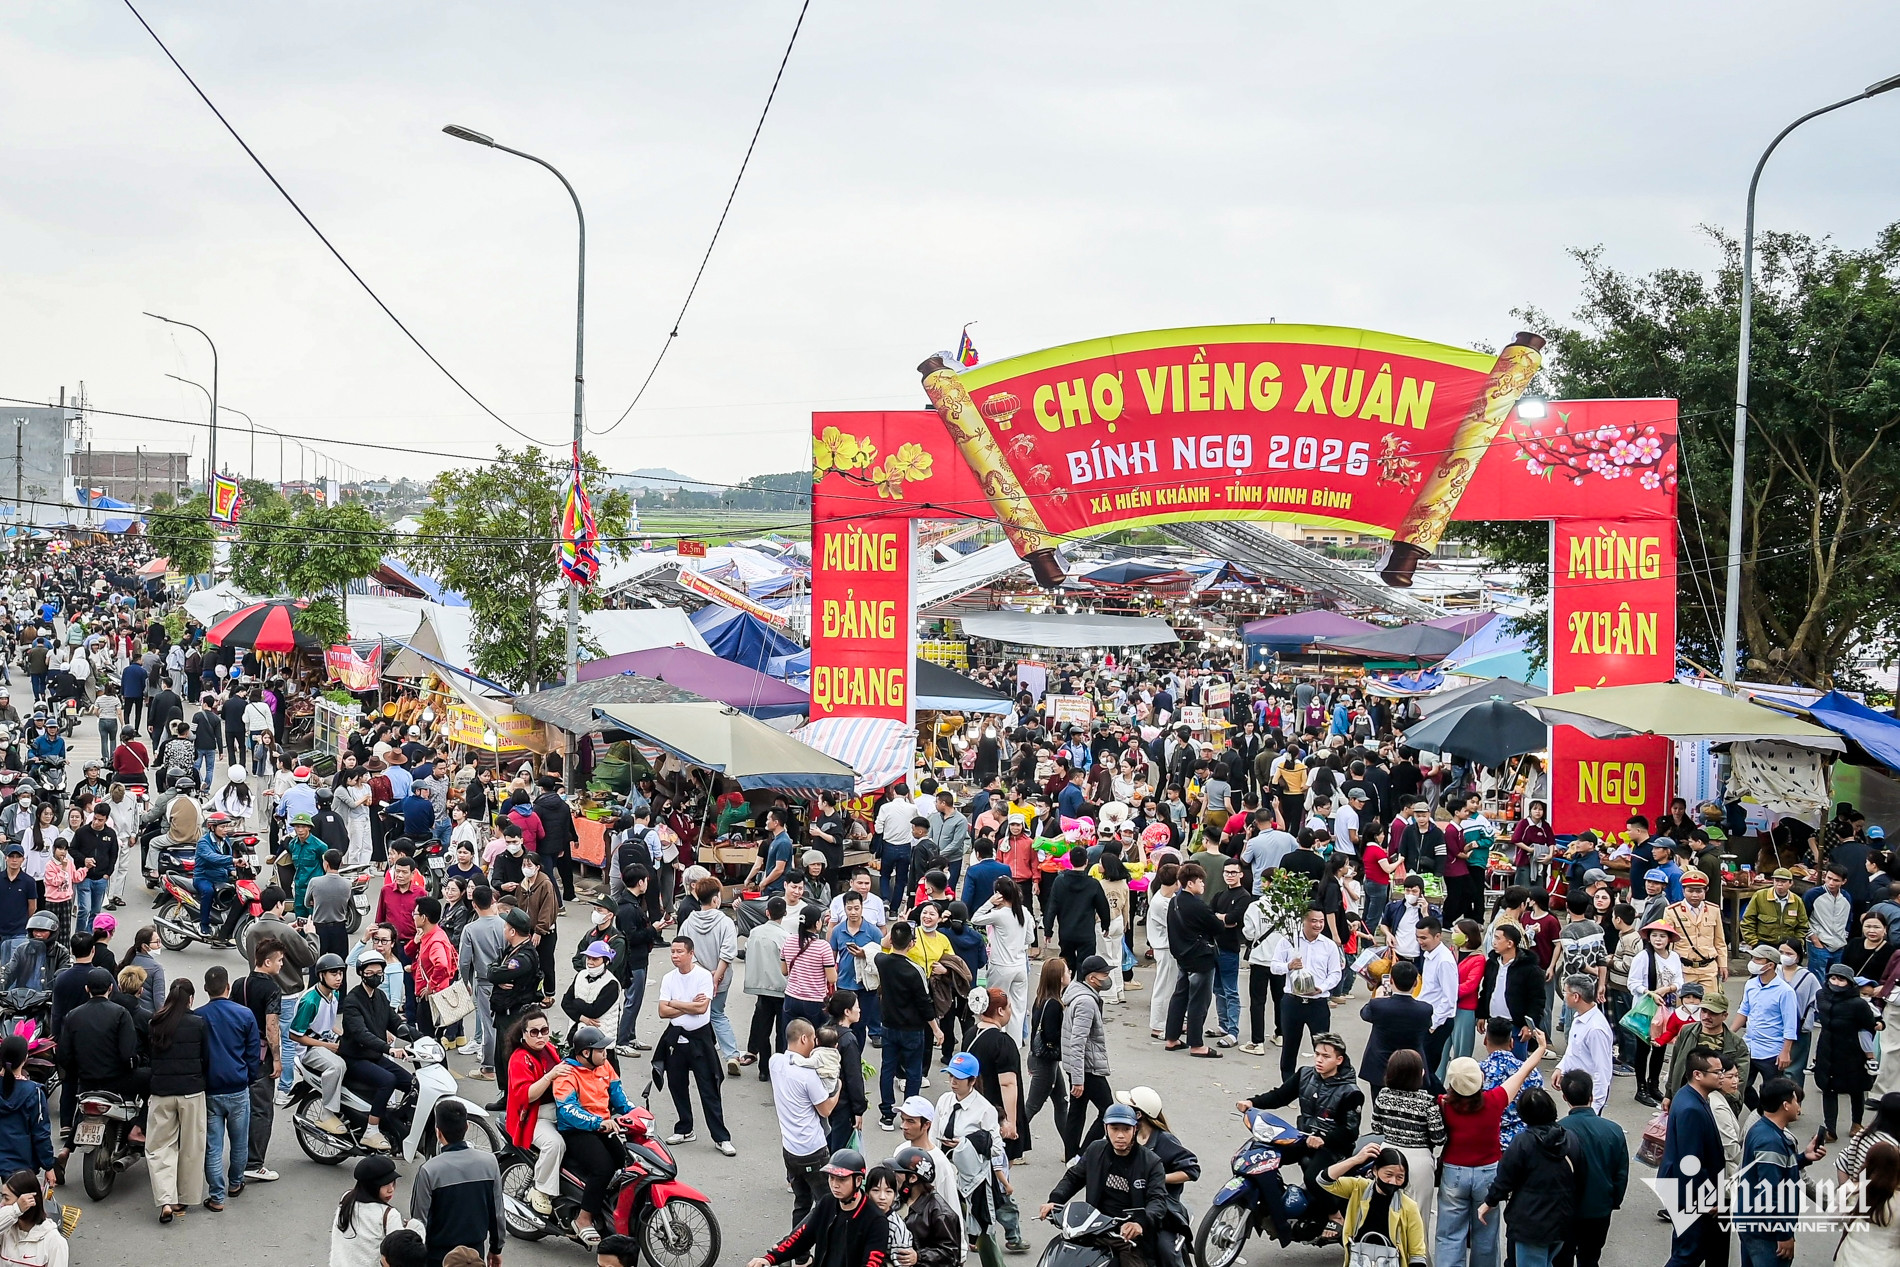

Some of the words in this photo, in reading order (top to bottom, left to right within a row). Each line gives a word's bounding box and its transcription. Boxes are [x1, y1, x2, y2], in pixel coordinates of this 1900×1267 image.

[1033, 369, 1124, 434] CHỢ
[1136, 346, 1283, 416] VIỀNG
[1294, 363, 1436, 430] XUÂN
[1066, 438, 1157, 485] BÍNH
[1172, 434, 1252, 476] NGỌ
[1268, 436, 1370, 477] 2026
[1090, 491, 1114, 514] XÃ
[1156, 484, 1210, 505] KHÁNH
[1226, 483, 1262, 504] TỈNH
[1267, 489, 1307, 506] NINH
[1311, 487, 1353, 510] BÌNH
[822, 523, 897, 572] MỪNG
[1567, 525, 1661, 580] MỪNG
[822, 588, 896, 639] ĐẢNG
[1568, 601, 1658, 656] XUÂN
[813, 666, 904, 713] QUANG
[1577, 760, 1646, 816] NGỌ
